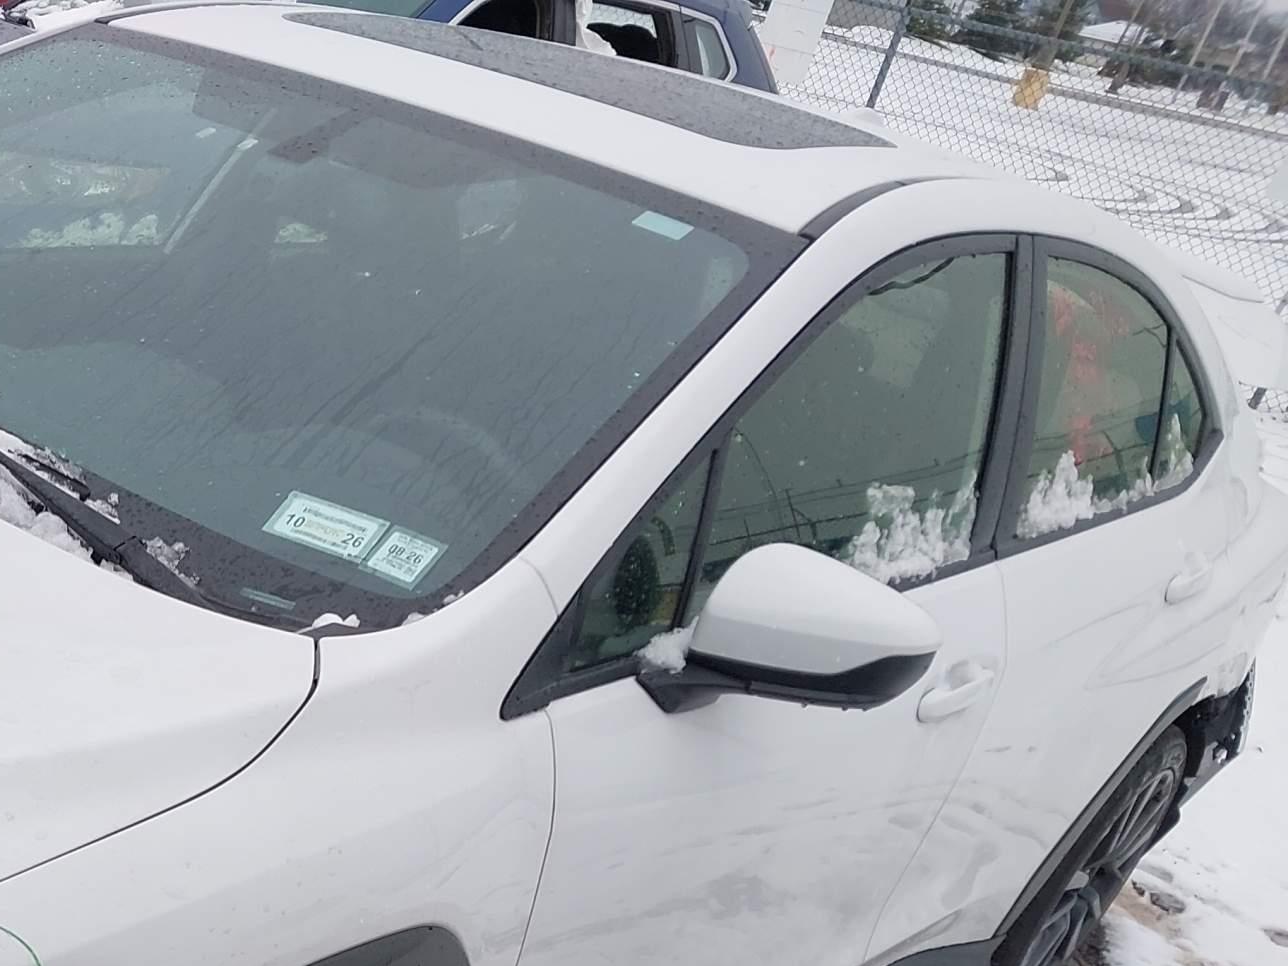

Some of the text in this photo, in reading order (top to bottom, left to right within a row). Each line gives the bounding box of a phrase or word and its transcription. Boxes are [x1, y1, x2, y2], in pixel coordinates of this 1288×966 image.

[285, 513, 306, 528] 10
[340, 532, 365, 548] 26
[405, 551, 424, 565] 26
